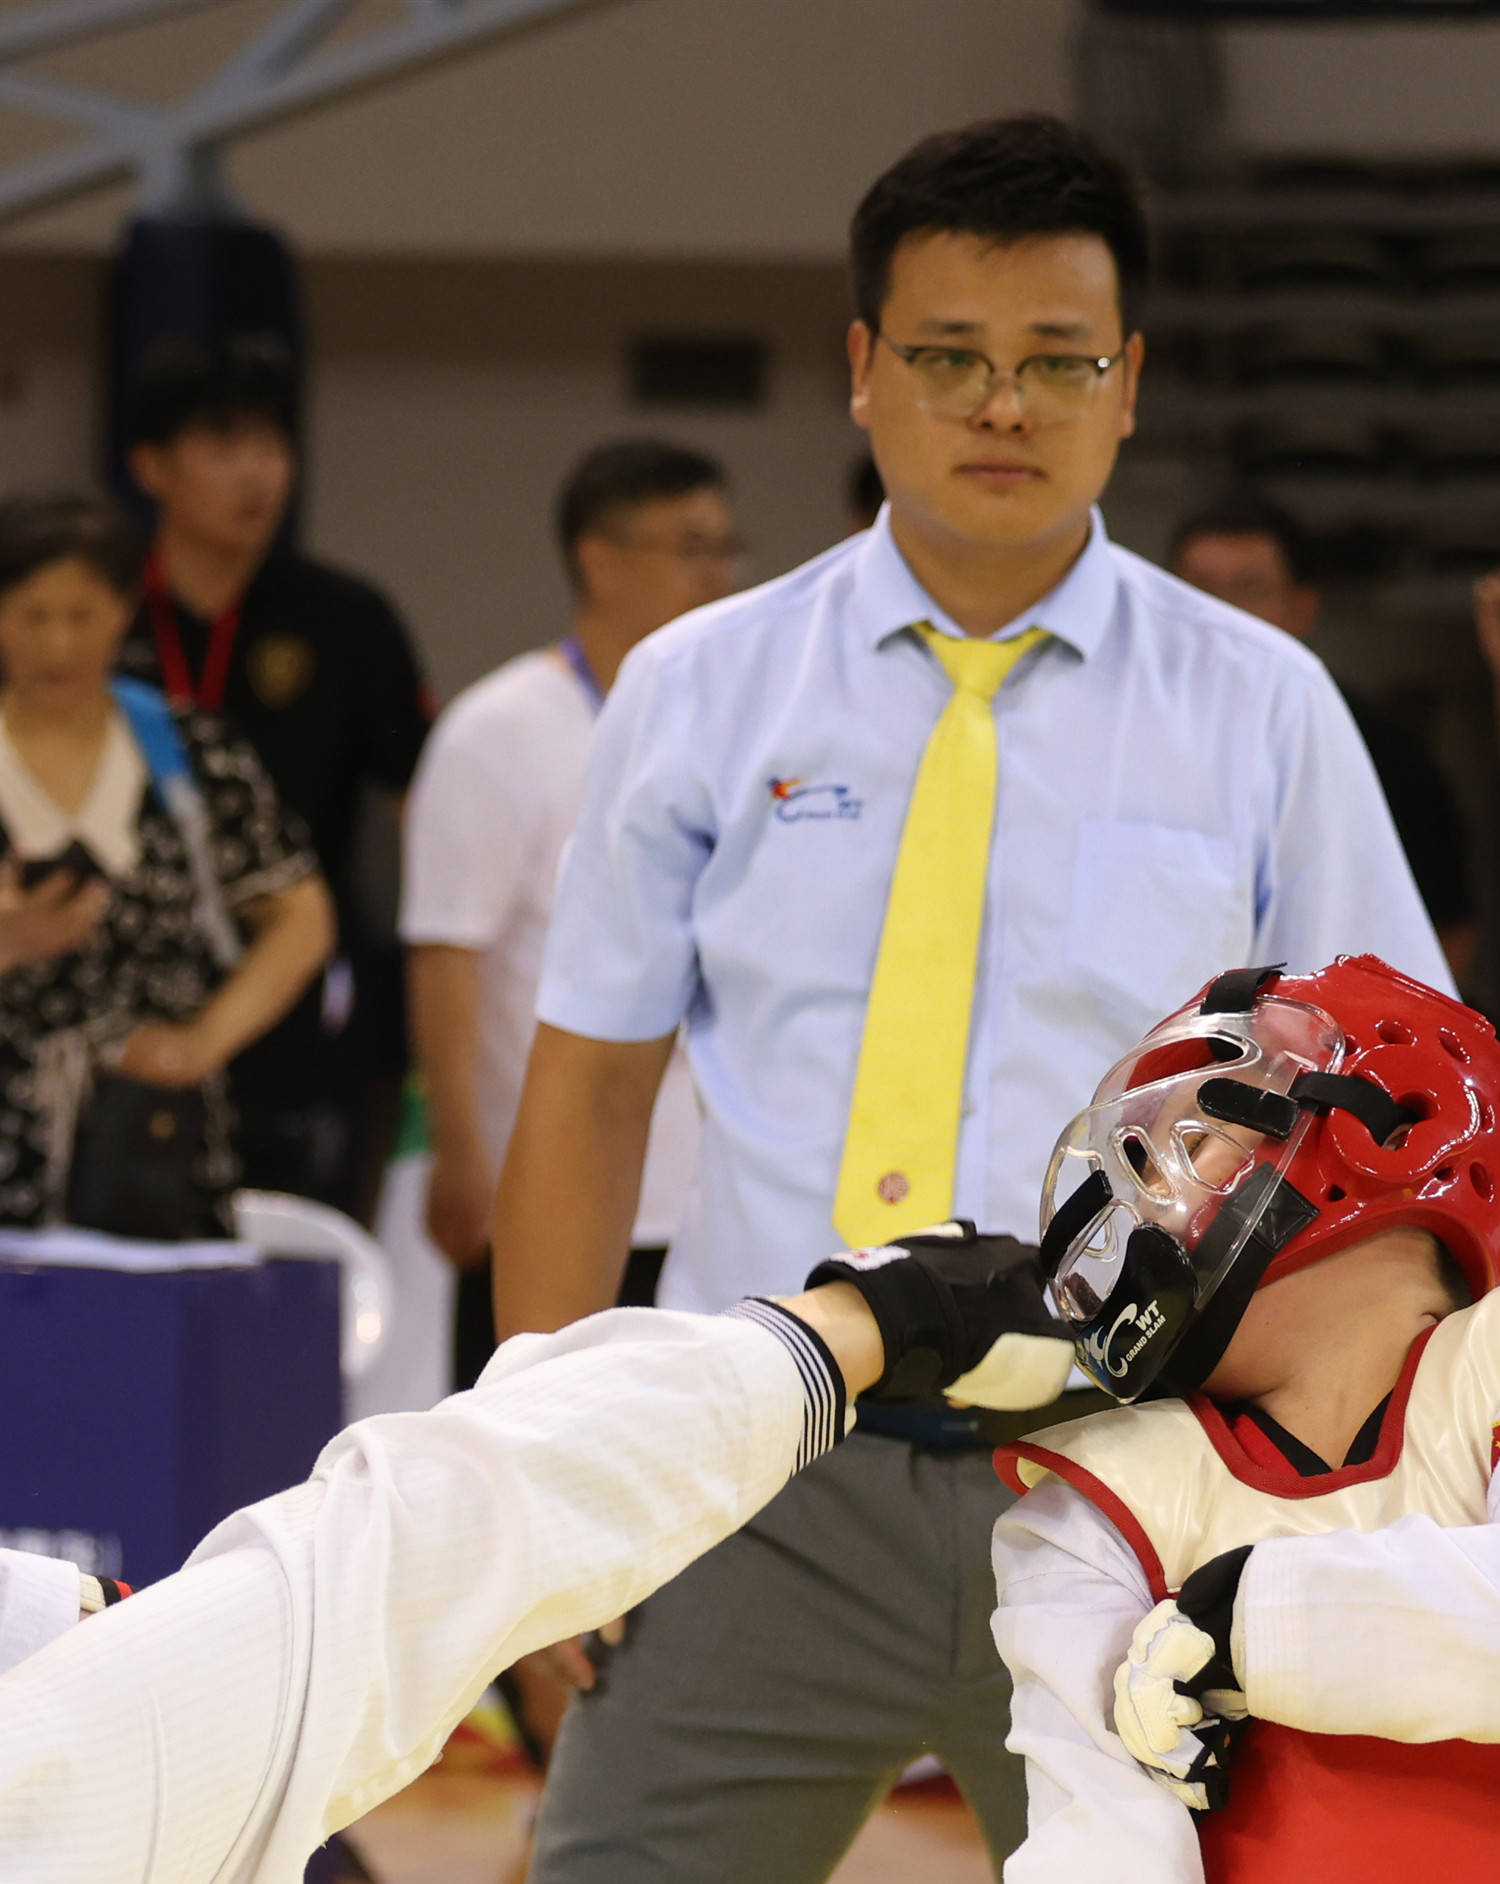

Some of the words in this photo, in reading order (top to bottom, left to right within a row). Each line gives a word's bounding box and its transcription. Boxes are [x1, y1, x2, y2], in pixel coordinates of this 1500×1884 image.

[1135, 1300, 1160, 1331] WT
[1125, 1335, 1148, 1362] GRAND
[1145, 1314, 1167, 1339] SLAM
